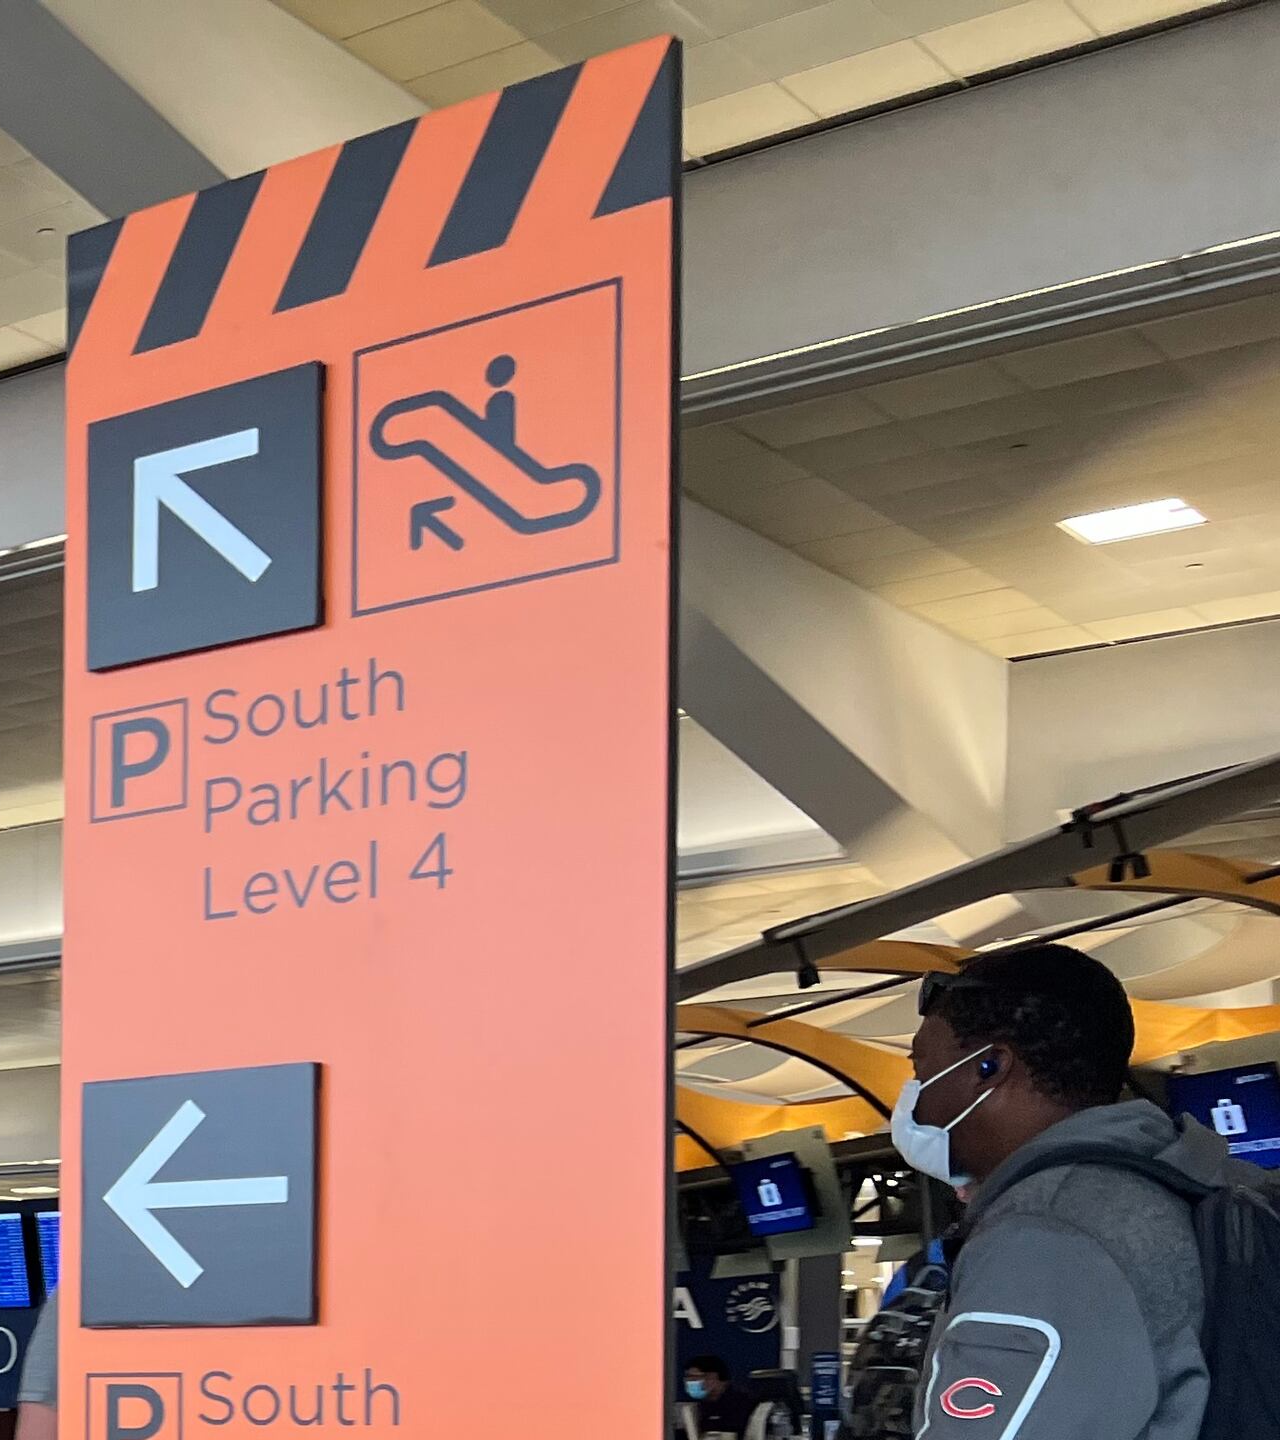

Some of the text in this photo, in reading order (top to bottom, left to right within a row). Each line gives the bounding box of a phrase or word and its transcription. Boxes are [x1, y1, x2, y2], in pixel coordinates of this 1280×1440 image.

[203, 658, 406, 744] South
[111, 717, 170, 808] P
[204, 750, 468, 833] Parking
[203, 832, 454, 920] Level 4
[198, 1367, 401, 1427] South
